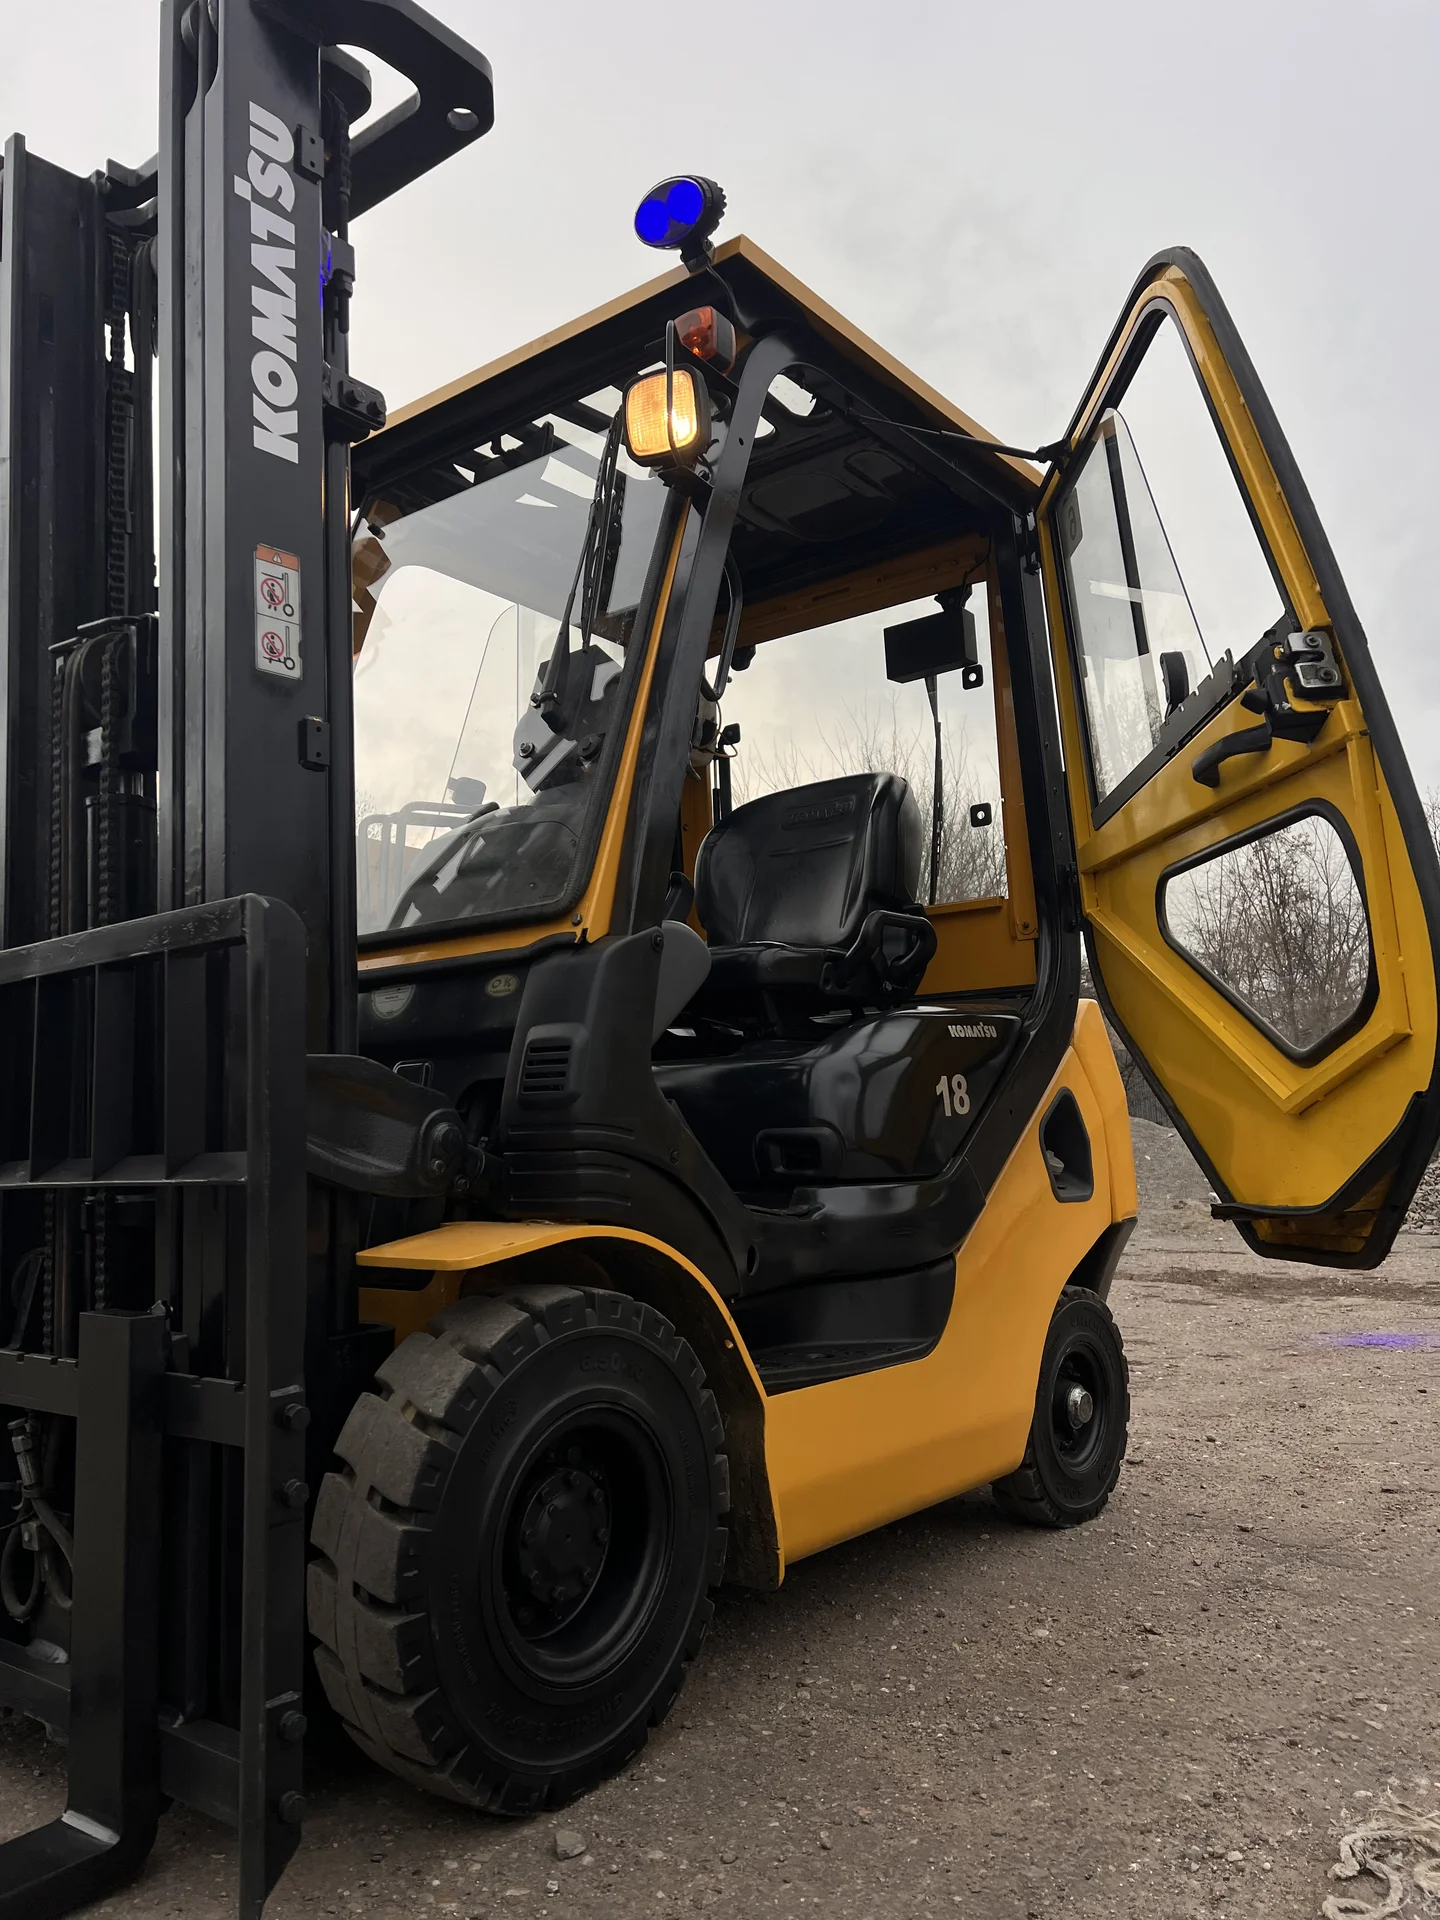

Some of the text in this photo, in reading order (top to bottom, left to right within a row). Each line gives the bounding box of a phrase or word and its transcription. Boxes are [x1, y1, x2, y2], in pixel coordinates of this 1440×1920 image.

[234, 100, 298, 463] KOMATSU
[948, 1022, 997, 1038] KOMATSU
[935, 1074, 971, 1117] 18
